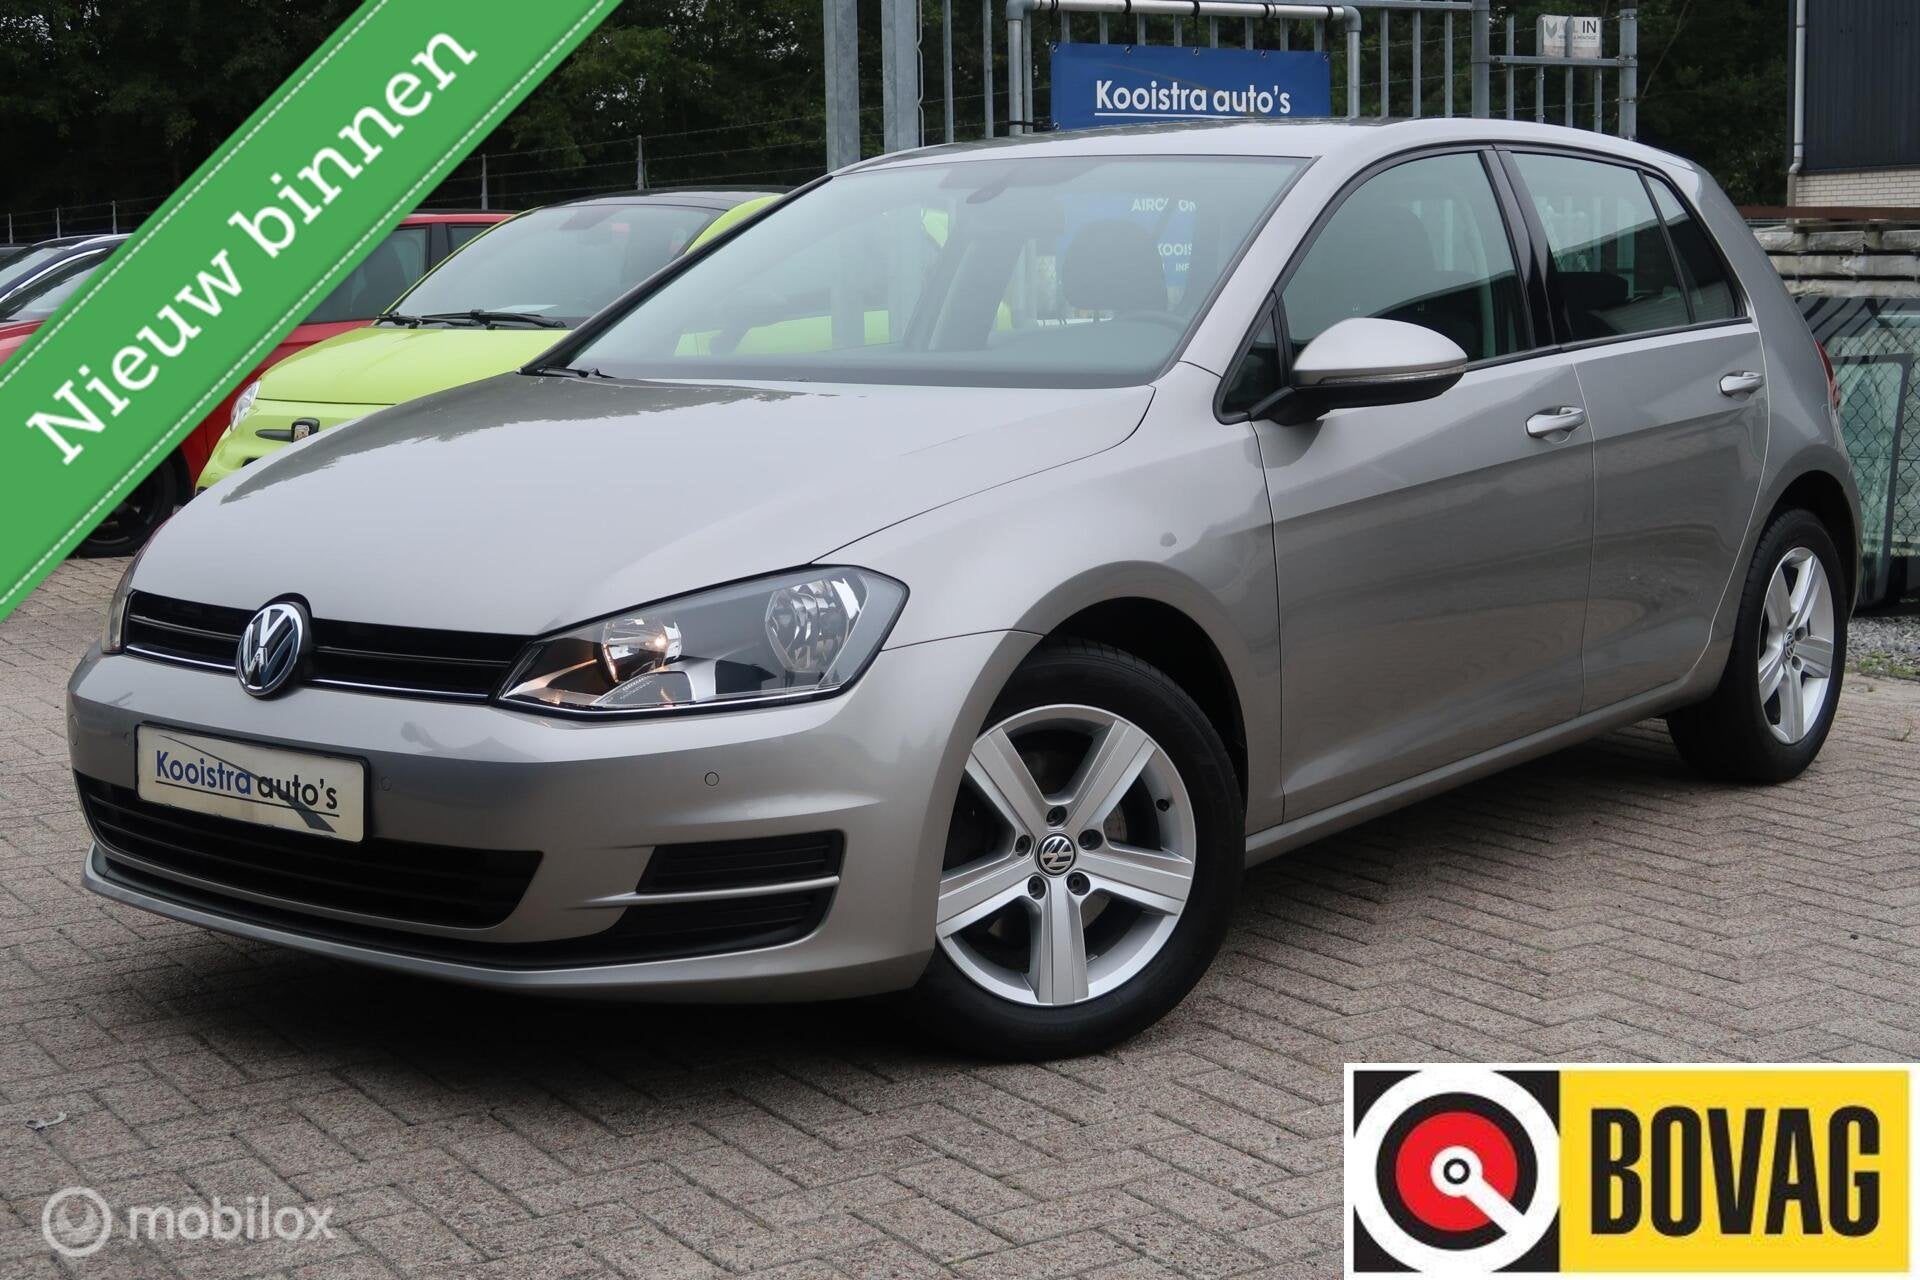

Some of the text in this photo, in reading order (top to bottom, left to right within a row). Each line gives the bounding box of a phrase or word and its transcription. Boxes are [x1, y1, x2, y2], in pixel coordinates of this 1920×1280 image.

[1582, 20, 1597, 34] IN
[1096, 80, 1291, 114] Kooistra auto's
[1131, 197, 1169, 212] AIRC
[156, 750, 338, 810] Kooistra auto's
